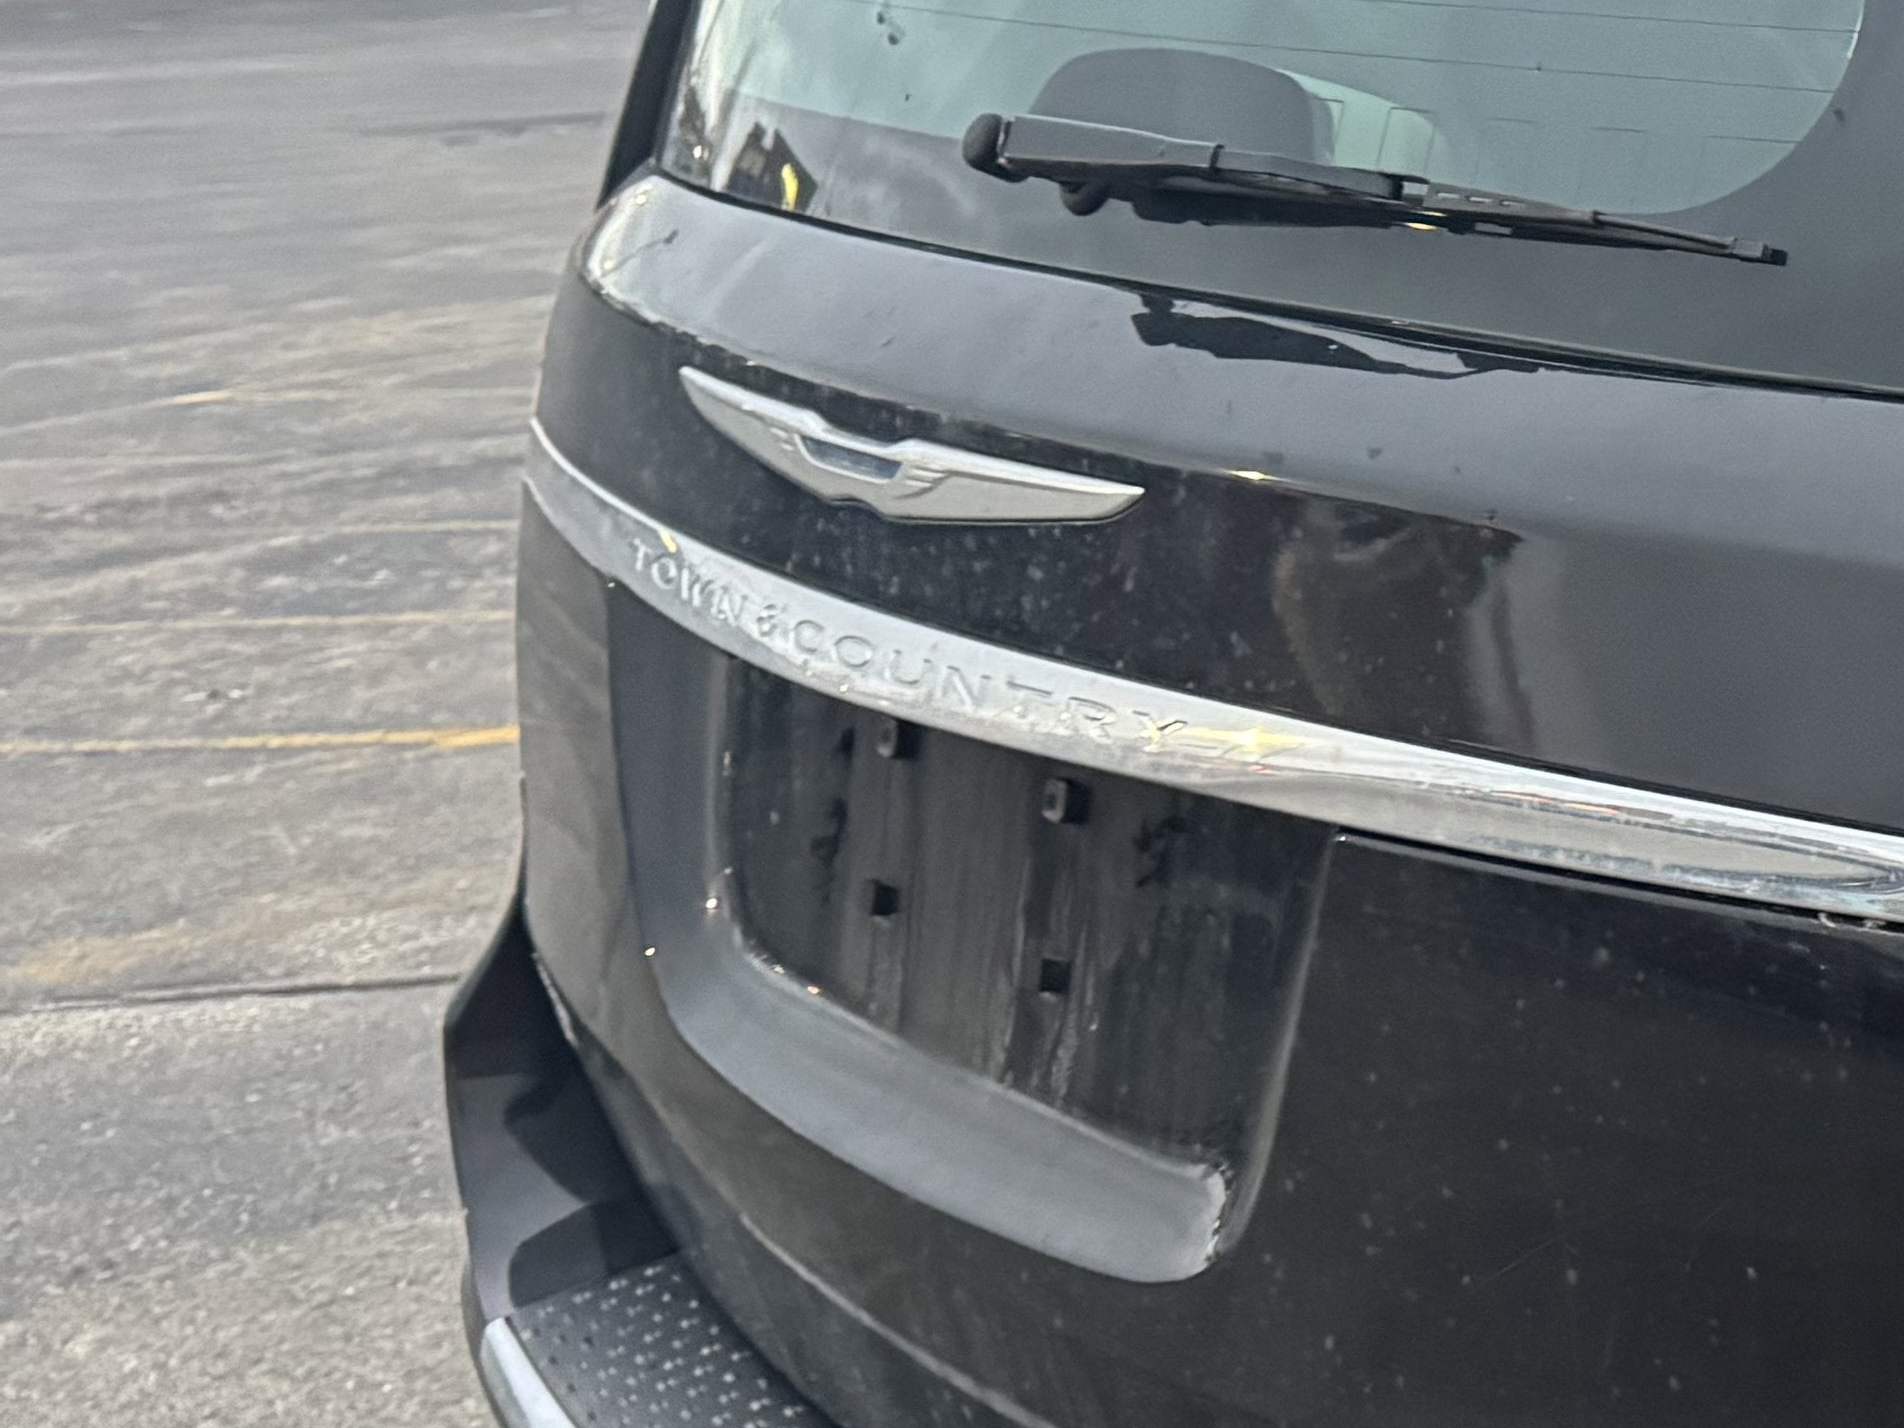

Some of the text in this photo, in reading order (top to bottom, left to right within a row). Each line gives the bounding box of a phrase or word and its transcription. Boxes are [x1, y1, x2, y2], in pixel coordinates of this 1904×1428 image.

[632, 538, 1189, 754] TOWN & COUNTRY
